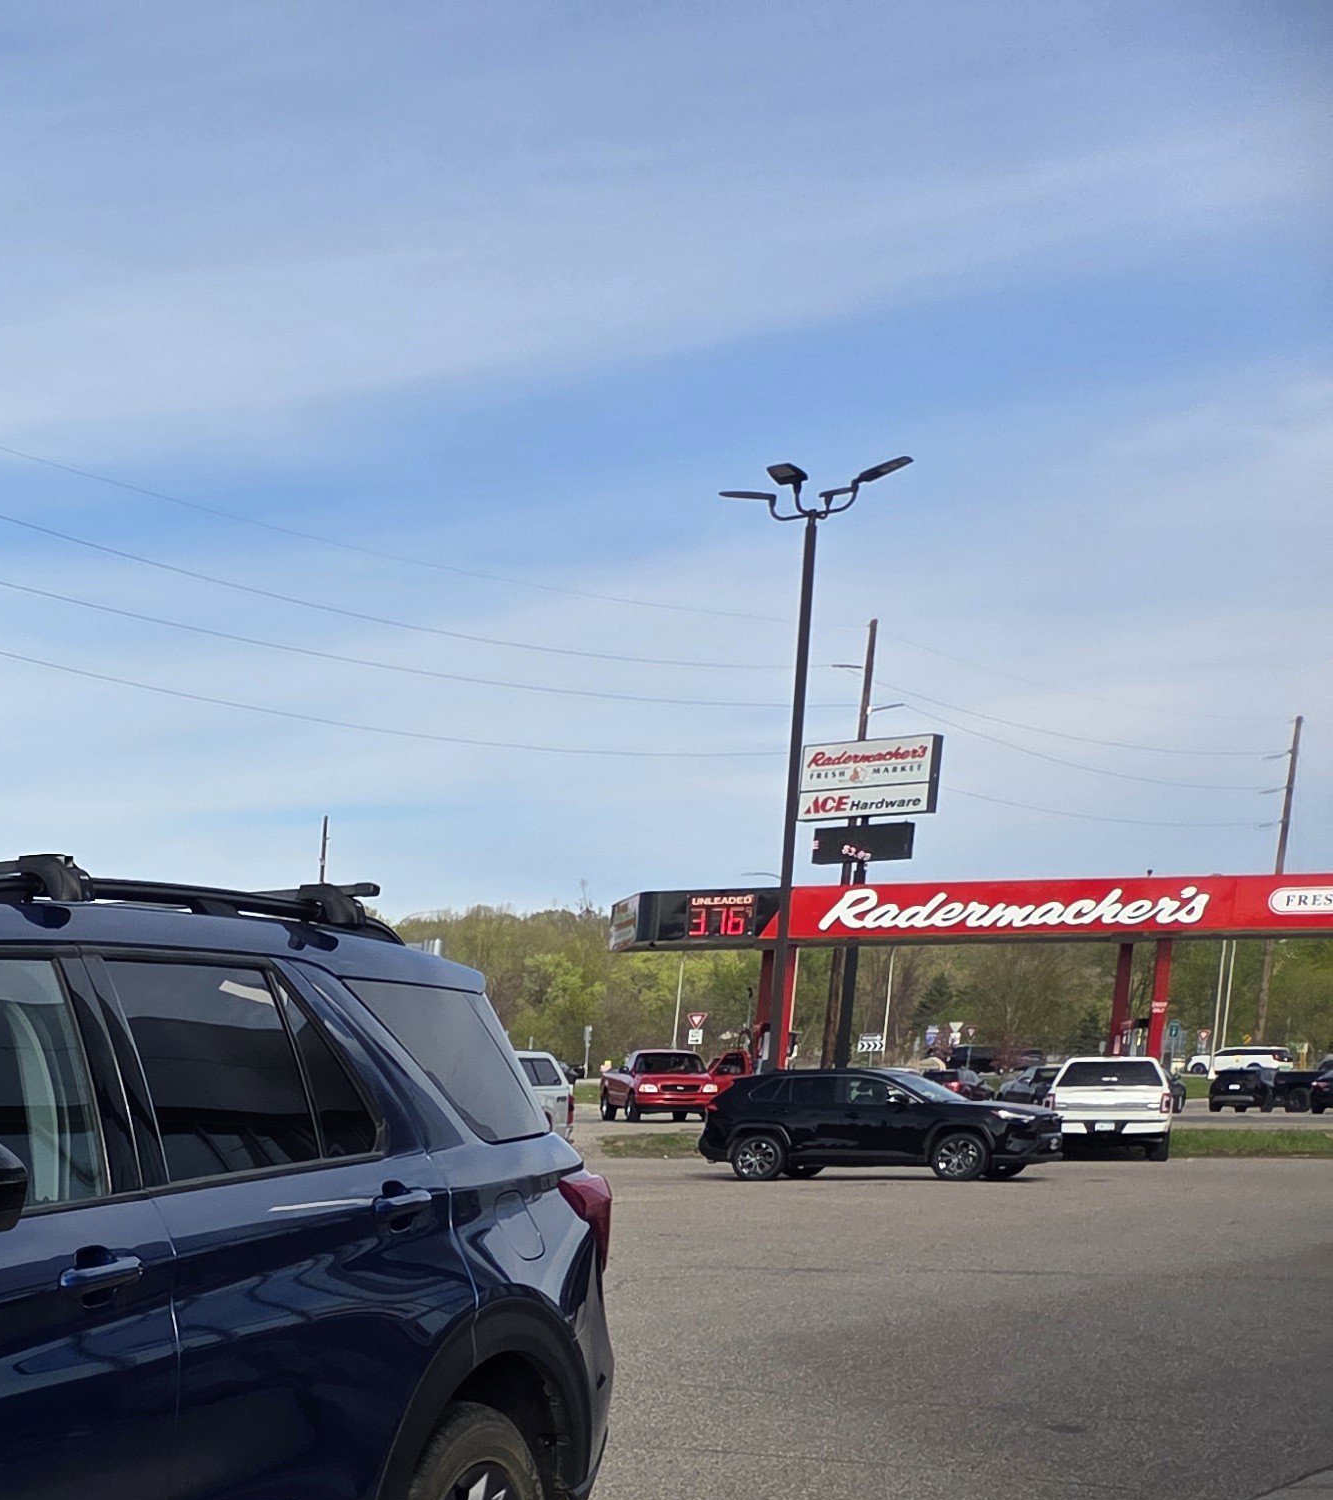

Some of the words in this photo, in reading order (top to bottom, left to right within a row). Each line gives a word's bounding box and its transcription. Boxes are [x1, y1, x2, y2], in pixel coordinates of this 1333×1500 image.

[807, 745, 928, 768] Radermacher's
[810, 771, 846, 780] FRESH
[872, 764, 923, 775] MARKET
[804, 795, 850, 815] ACE
[849, 797, 922, 811] Hardware
[691, 895, 753, 906] UNLEADED
[819, 886, 1211, 931] Radermacher's
[1286, 893, 1333, 907] FRES
